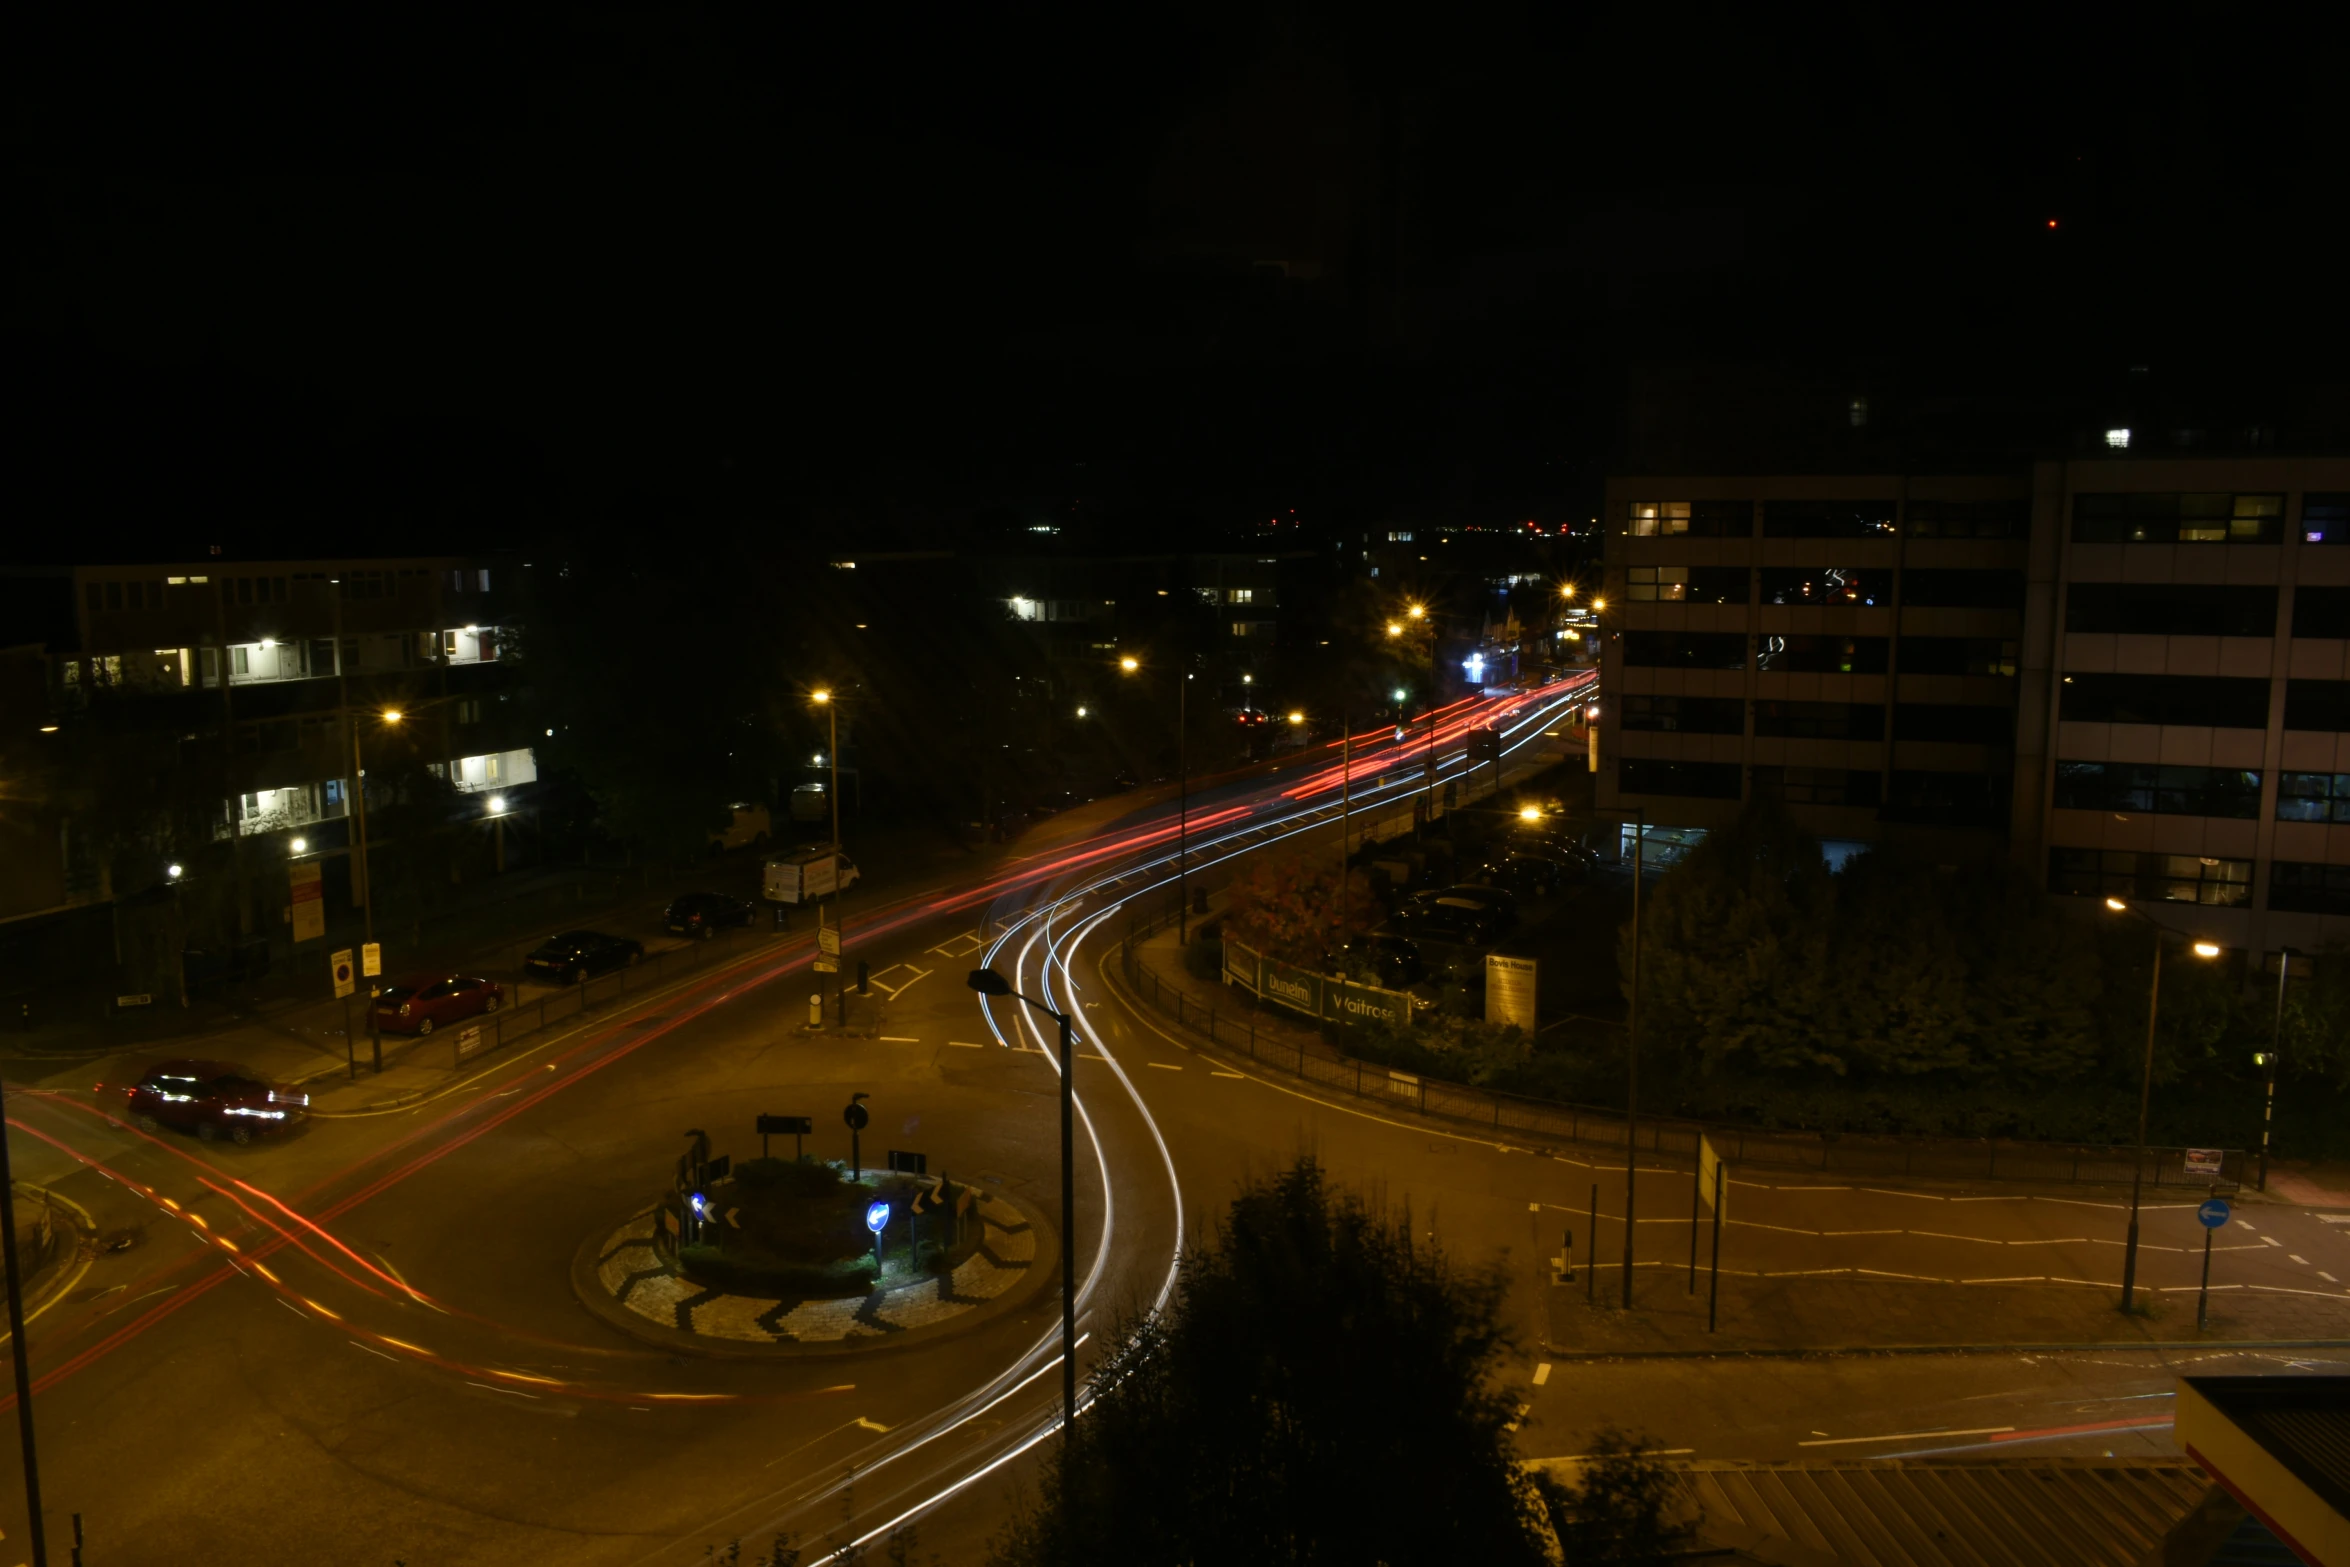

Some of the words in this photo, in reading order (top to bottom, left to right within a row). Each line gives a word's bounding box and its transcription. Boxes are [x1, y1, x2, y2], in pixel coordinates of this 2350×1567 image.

[1489, 958, 1509, 968] Bovis
[1511, 960, 1533, 971] House
[1269, 973, 1309, 1002] Dunelm
